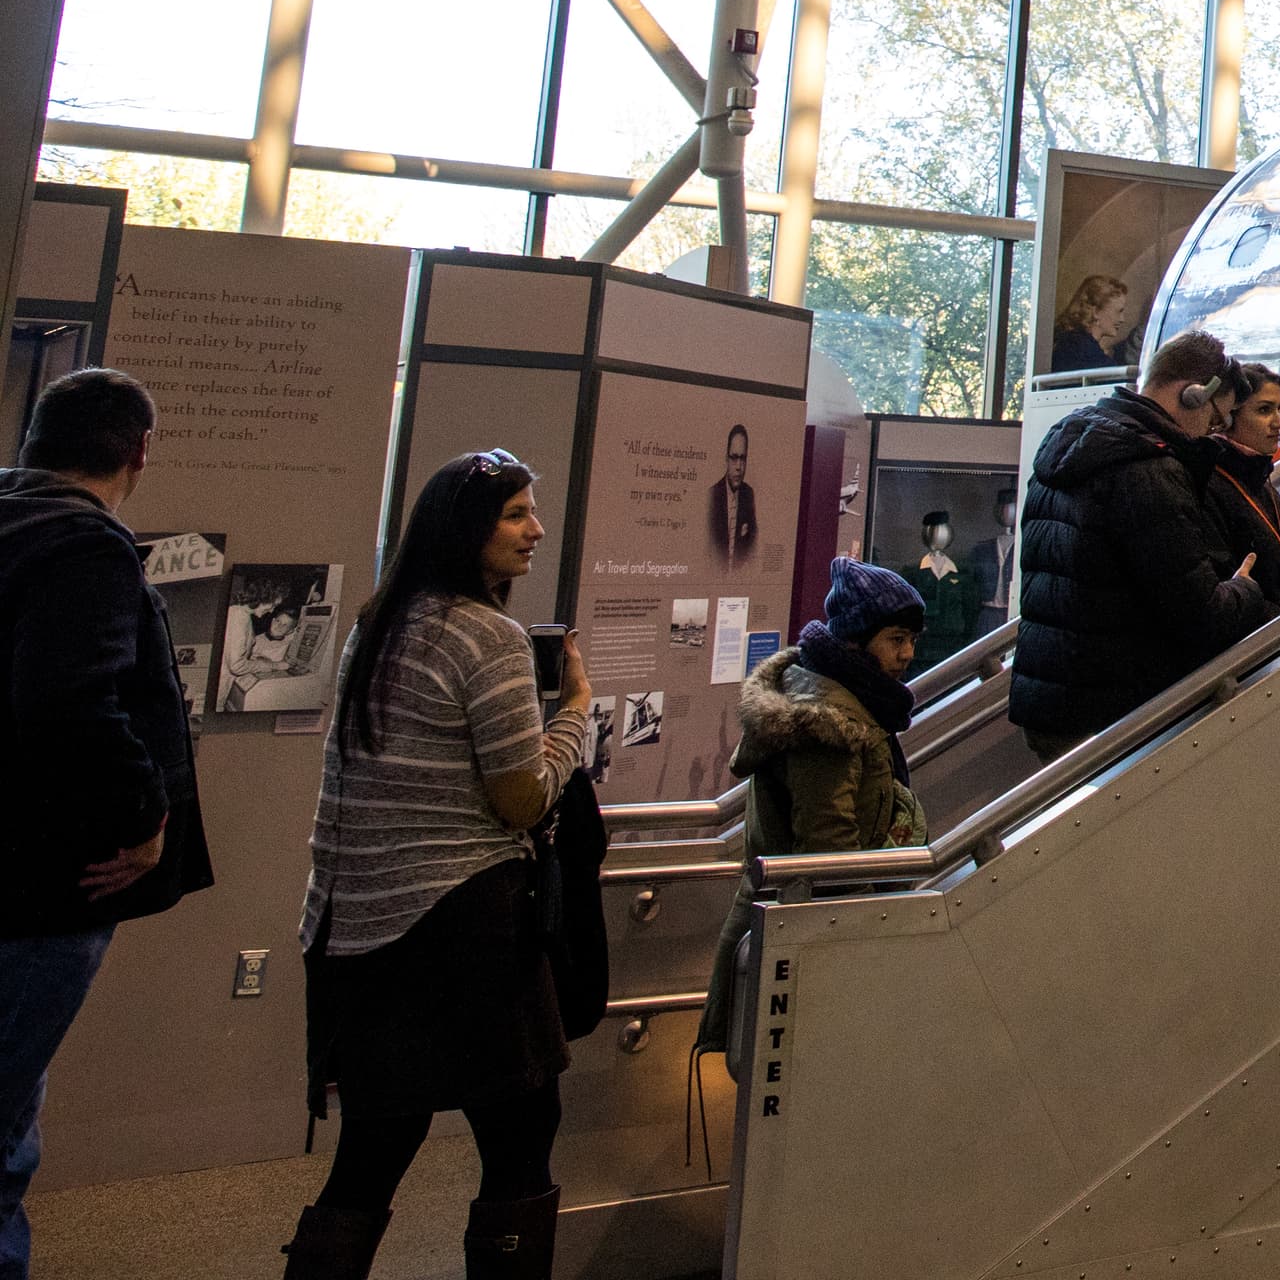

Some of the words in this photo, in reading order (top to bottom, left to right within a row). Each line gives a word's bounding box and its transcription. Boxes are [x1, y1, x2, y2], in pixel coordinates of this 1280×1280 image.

[222, 289, 258, 305] have
[263, 296, 281, 306] an
[287, 294, 344, 312] abiding
[132, 307, 179, 322] belief
[183, 311, 198, 323] in
[204, 310, 241, 326] their
[246, 313, 296, 331] ability
[301, 318, 316, 330] to
[113, 331, 172, 345] control
[178, 334, 230, 352] reality
[235, 335, 253, 352] by
[259, 339, 308, 356] purely
[115, 355, 184, 369] material
[263, 359, 322, 376] Airline
[184, 380, 248, 396] replaces
[252, 382, 277, 396] the
[283, 383, 313, 398] fear
[317, 385, 334, 399] of
[159, 402, 195, 416] with
[201, 403, 225, 417] the
[231, 405, 319, 423] comforting
[152, 427, 193, 441] spect
[198, 426, 217, 439] of
[642, 441, 652, 455] of
[652, 442, 672, 458] these
[673, 445, 707, 460] incidents
[221, 461, 238, 470] Me
[640, 465, 679, 480] witnessed
[680, 467, 697, 481] with
[630, 490, 642, 504] my
[645, 491, 662, 501] own
[593, 560, 606, 574] Air
[608, 560, 629, 574] Travel
[630, 560, 646, 574] and
[646, 560, 689, 577] Segregation
[763, 960, 790, 1117] ENTER
